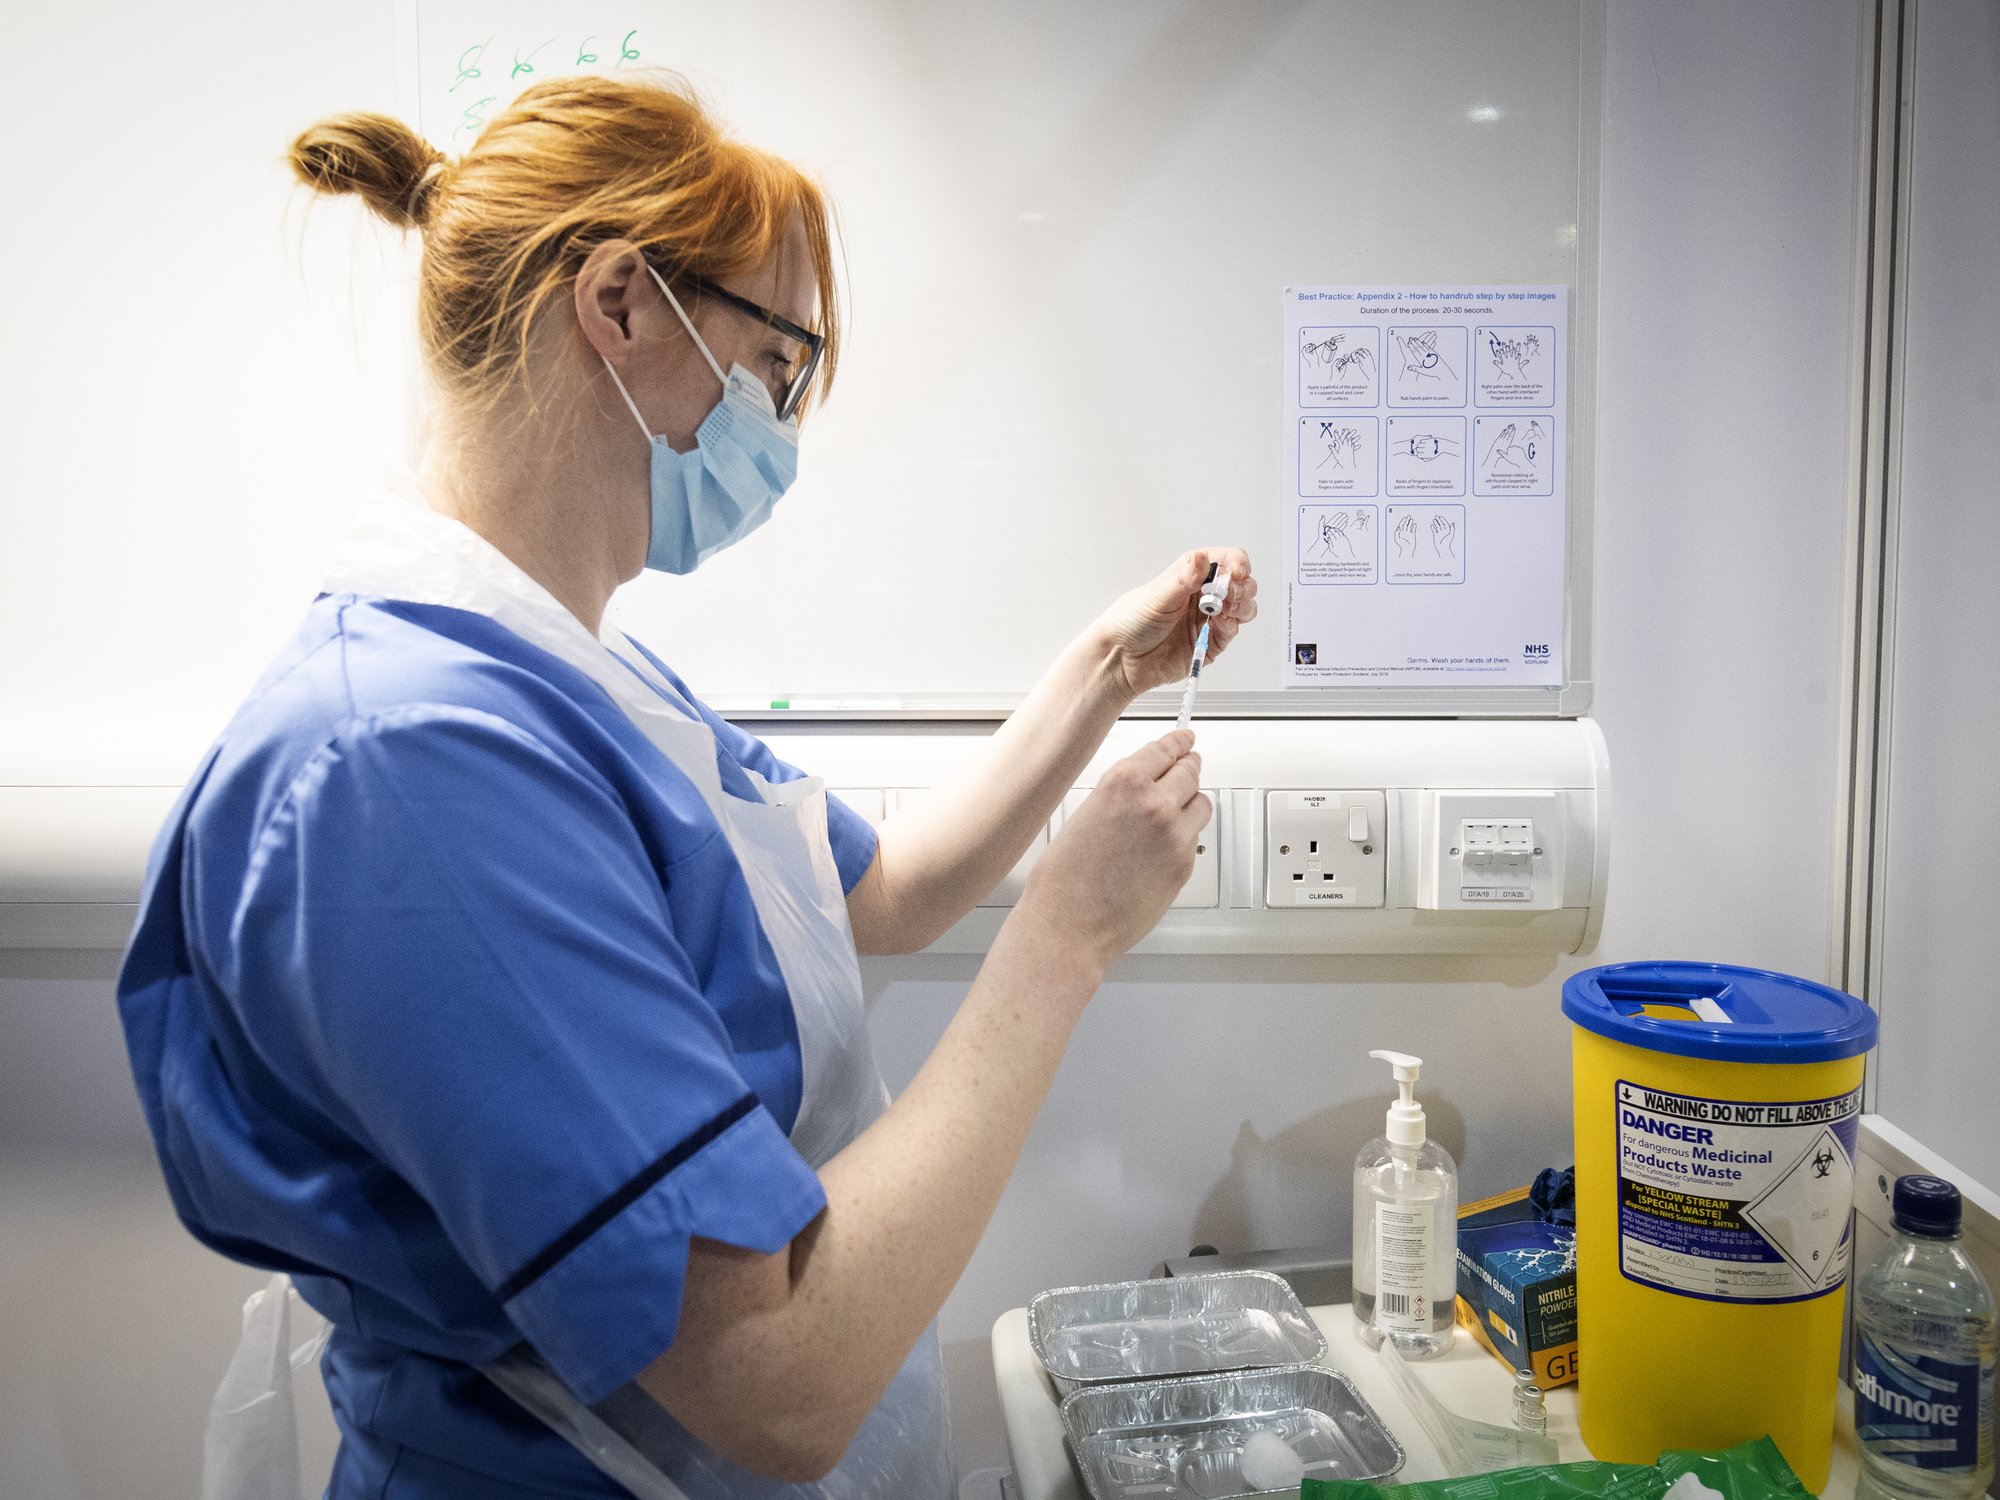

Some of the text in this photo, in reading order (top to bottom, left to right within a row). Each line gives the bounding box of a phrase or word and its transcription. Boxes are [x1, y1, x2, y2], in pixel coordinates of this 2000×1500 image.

[1298, 293, 1317, 301] Best
[1319, 292, 1355, 300] Practice:
[1356, 292, 1395, 302] Appendix
[1476, 293, 1493, 301] step
[1495, 292, 1506, 301] by
[1507, 293, 1525, 301] step
[1527, 292, 1556, 301] images
[1525, 644, 1549, 653] NHS
[1644, 1092, 1708, 1118] WARNING
[1712, 1104, 1732, 1121] DO
[1736, 1106, 1765, 1122] NOT
[1767, 1108, 1793, 1123] FILL
[1795, 1102, 1831, 1122] ABOVE
[1834, 1098, 1848, 1115] THE
[1623, 1110, 1714, 1146] DANGER
[1623, 1132, 1772, 1163] For dangerous Medicinal
[1623, 1146, 1742, 1180] Products Waste
[1623, 1159, 1633, 1167] (but
[1634, 1163, 1646, 1171] NOT
[1646, 1166, 1674, 1179] Cytotoxic
[1682, 1175, 1714, 1186] Cytostatic
[1623, 1166, 1680, 1188] from Chemotherapy)
[1631, 1183, 1729, 1210] For YELLOW STREAM
[1638, 1194, 1722, 1220] [SPECIAL WASTE]
[1625, 1200, 1651, 1214] disposal
[1659, 1211, 1675, 1220] NHS
[1676, 1214, 1708, 1225] Scotland
[1712, 1220, 1733, 1228] SHTN
[1626, 1244, 1645, 1256] Location
[1812, 1250, 1819, 1261] 6
[1456, 1248, 1492, 1286] EXAMINATION
[1492, 1279, 1515, 1304] GLOVES
[1458, 1261, 1471, 1278] FREE
[1714, 1267, 1767, 1276] Practice/Dept/Ward
[1538, 1285, 1575, 1305] NITRILE
